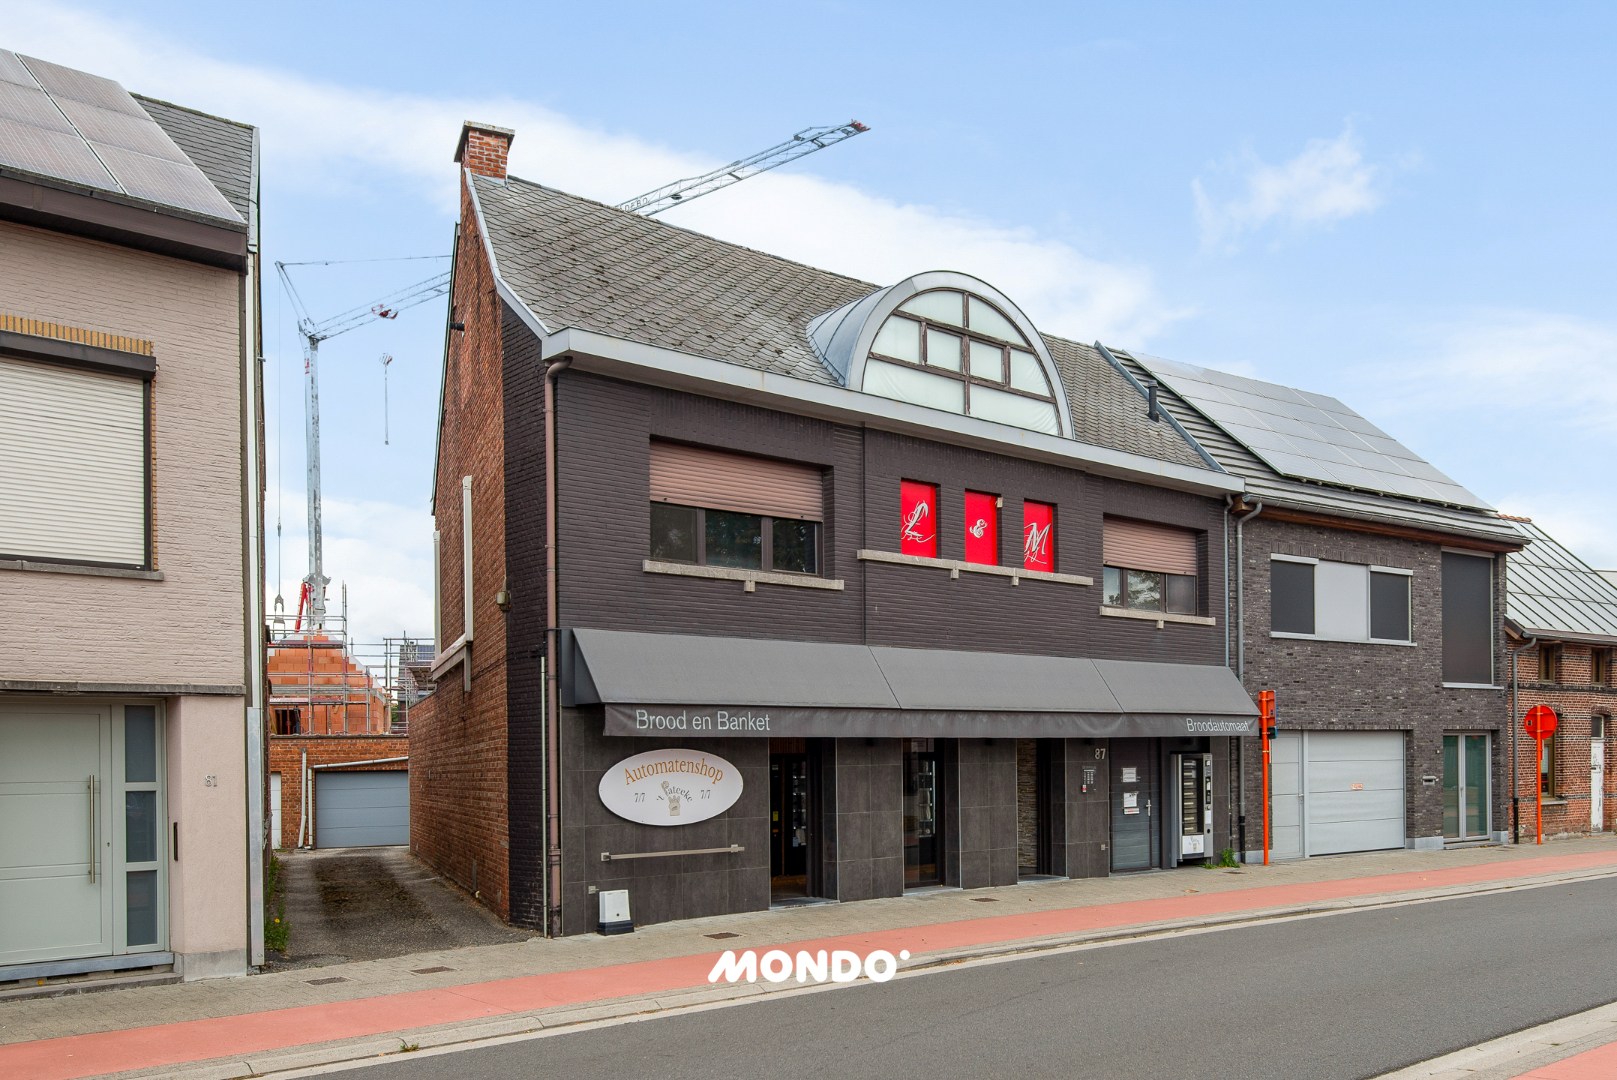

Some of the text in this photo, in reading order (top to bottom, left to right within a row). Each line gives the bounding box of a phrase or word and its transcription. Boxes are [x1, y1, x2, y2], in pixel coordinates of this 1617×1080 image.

[969, 518, 988, 539] &
[1024, 522, 1052, 564] M
[635, 709, 771, 731] Brood en Banket
[1186, 717, 1250, 732] Broodautomaat
[1094, 748, 1106, 760] 87
[624, 758, 724, 785] Automatenshop
